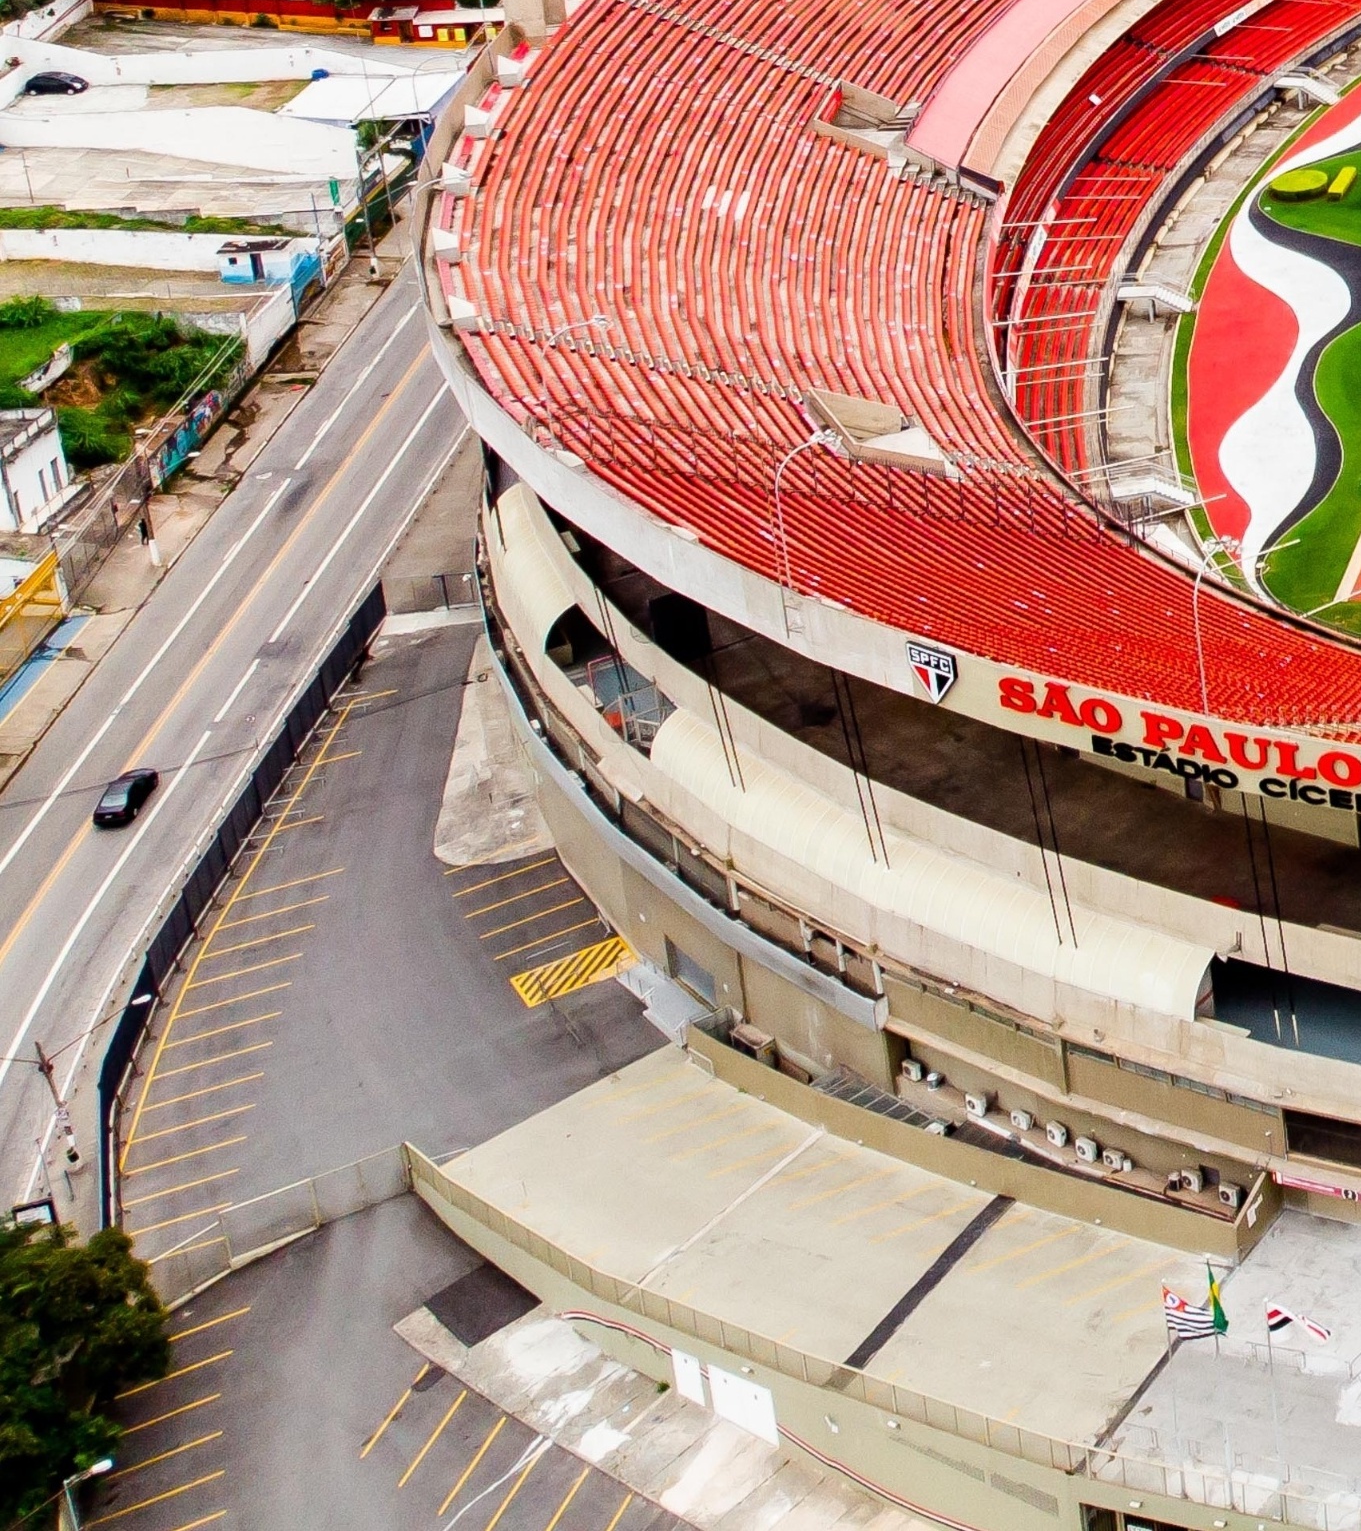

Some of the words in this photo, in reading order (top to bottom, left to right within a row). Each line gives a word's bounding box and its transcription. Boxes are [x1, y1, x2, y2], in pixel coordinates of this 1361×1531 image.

[909, 648, 953, 673] SPFC
[999, 678, 1122, 735] SÃO
[1091, 733, 1239, 791] ESTÁDIO
